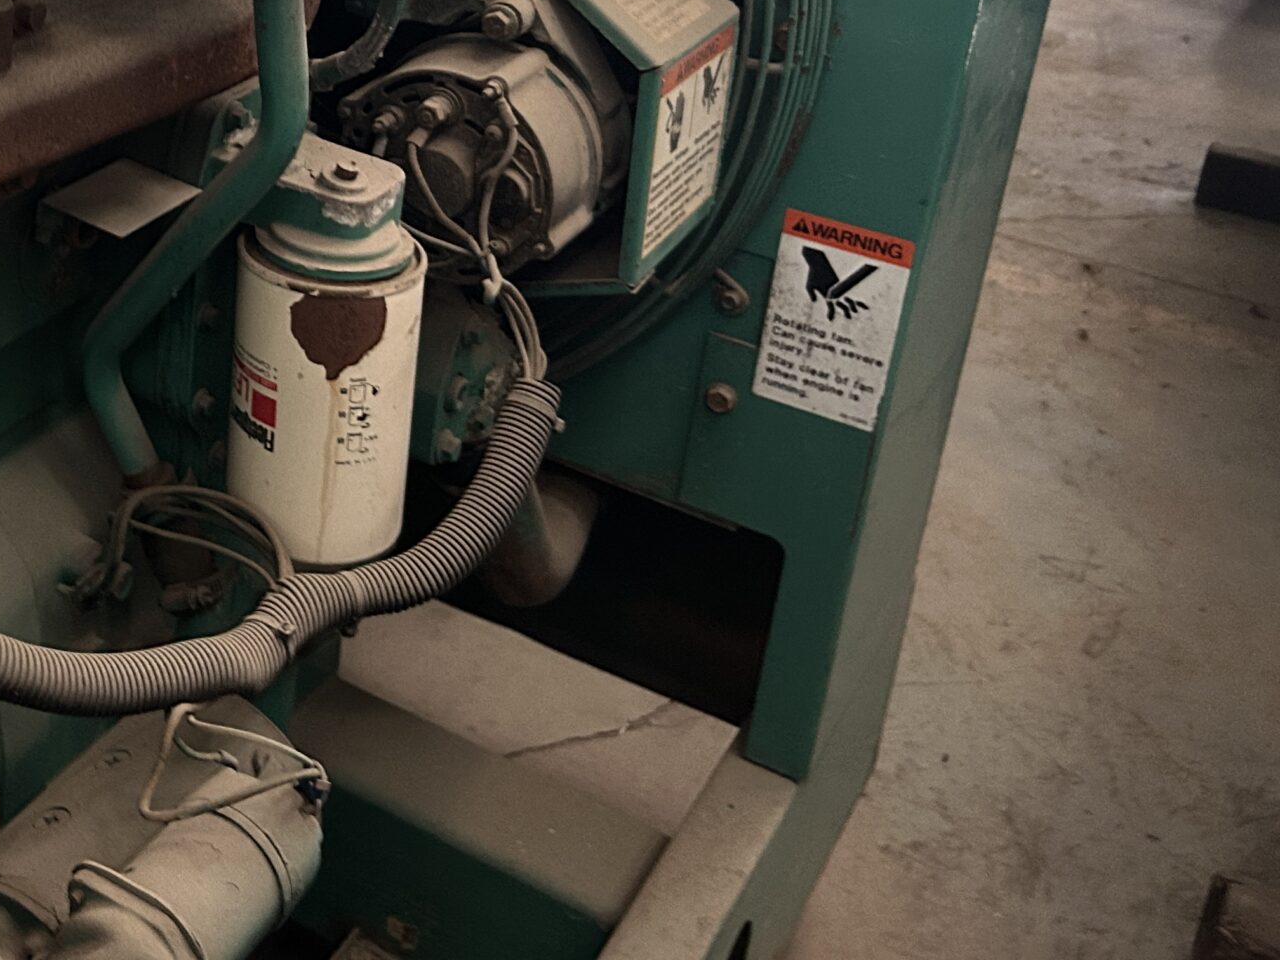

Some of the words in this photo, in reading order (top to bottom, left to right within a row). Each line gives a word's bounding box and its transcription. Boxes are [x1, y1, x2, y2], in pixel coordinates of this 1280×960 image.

[811, 221, 903, 260] WARNING
[773, 313, 826, 339] Rotating
[771, 325, 795, 340] Can
[840, 348, 883, 367] severe
[765, 366, 797, 382] when
[802, 378, 844, 397] engine
[848, 390, 860, 402] is
[767, 352, 794, 369] Stay
[799, 364, 830, 380] clear
[834, 373, 849, 386] of
[853, 379, 874, 394] fan
